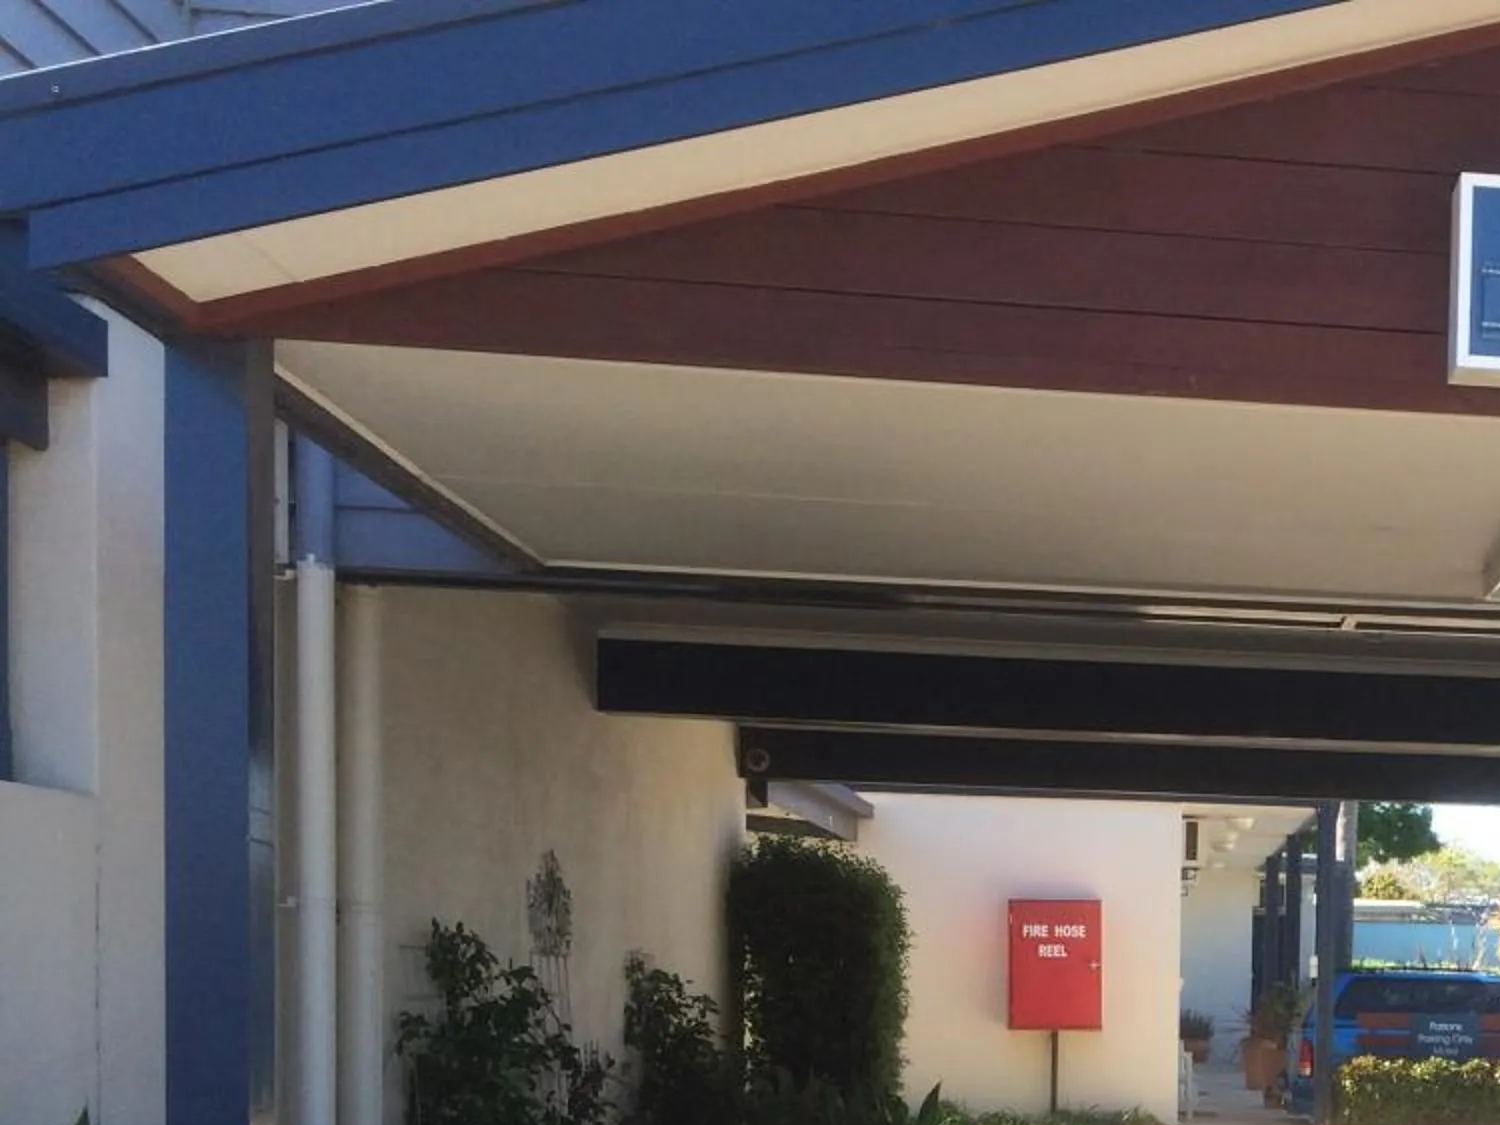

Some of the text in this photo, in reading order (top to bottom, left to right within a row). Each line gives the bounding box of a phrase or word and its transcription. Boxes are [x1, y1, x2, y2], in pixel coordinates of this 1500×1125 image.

[1023, 924, 1086, 938] FIRE HOSE
[1038, 943, 1068, 958] REEL
